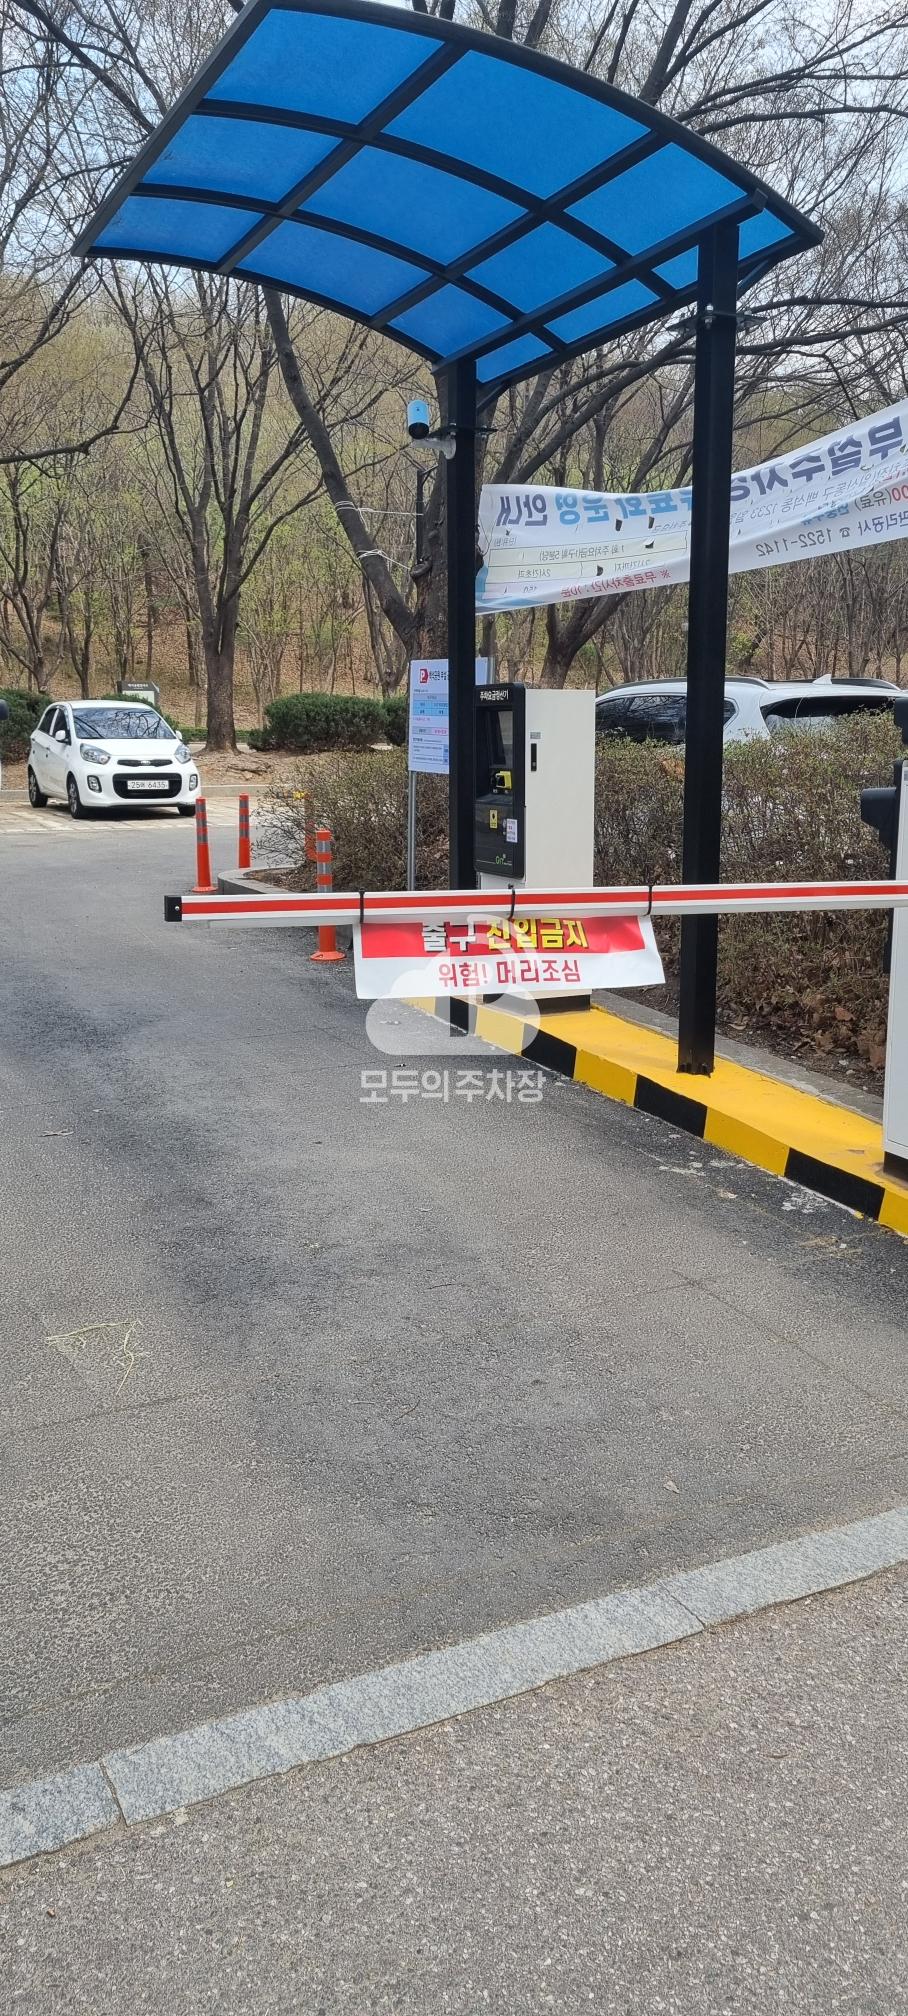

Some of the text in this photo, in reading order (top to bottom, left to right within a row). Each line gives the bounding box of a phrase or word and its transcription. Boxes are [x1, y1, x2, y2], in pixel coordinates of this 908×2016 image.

[421, 917, 589, 952] 출구 진입금지
[437, 959, 581, 988] 위험! 머리조심
